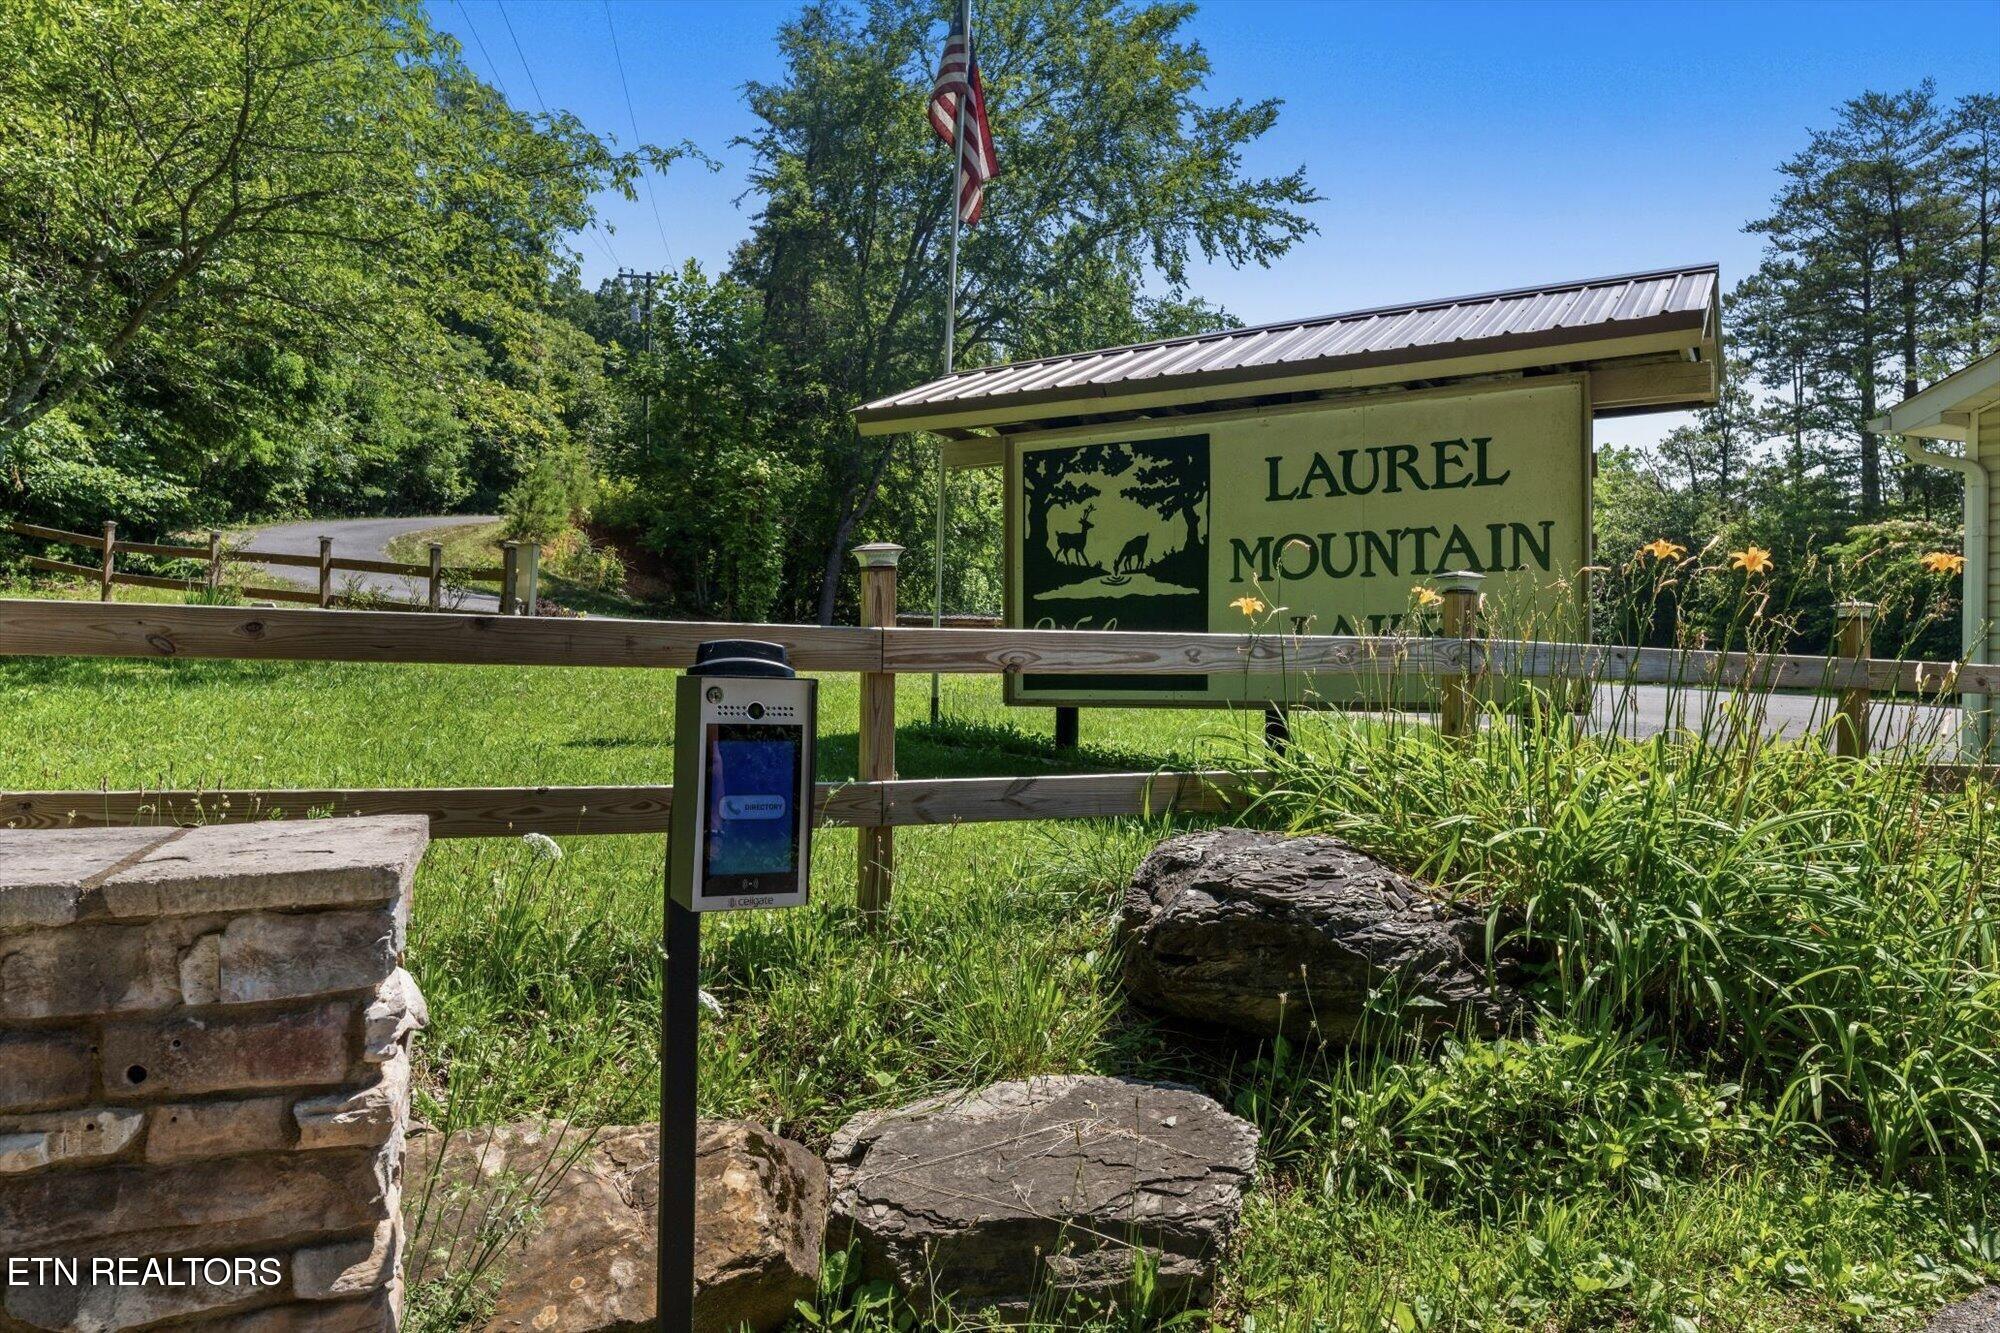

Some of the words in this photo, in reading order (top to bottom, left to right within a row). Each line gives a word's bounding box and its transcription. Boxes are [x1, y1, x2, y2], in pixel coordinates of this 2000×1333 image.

[1265, 437, 1511, 501] LAUREL
[1229, 520, 1555, 583] MOUNTAIN
[744, 803, 783, 811] DIRECTORY
